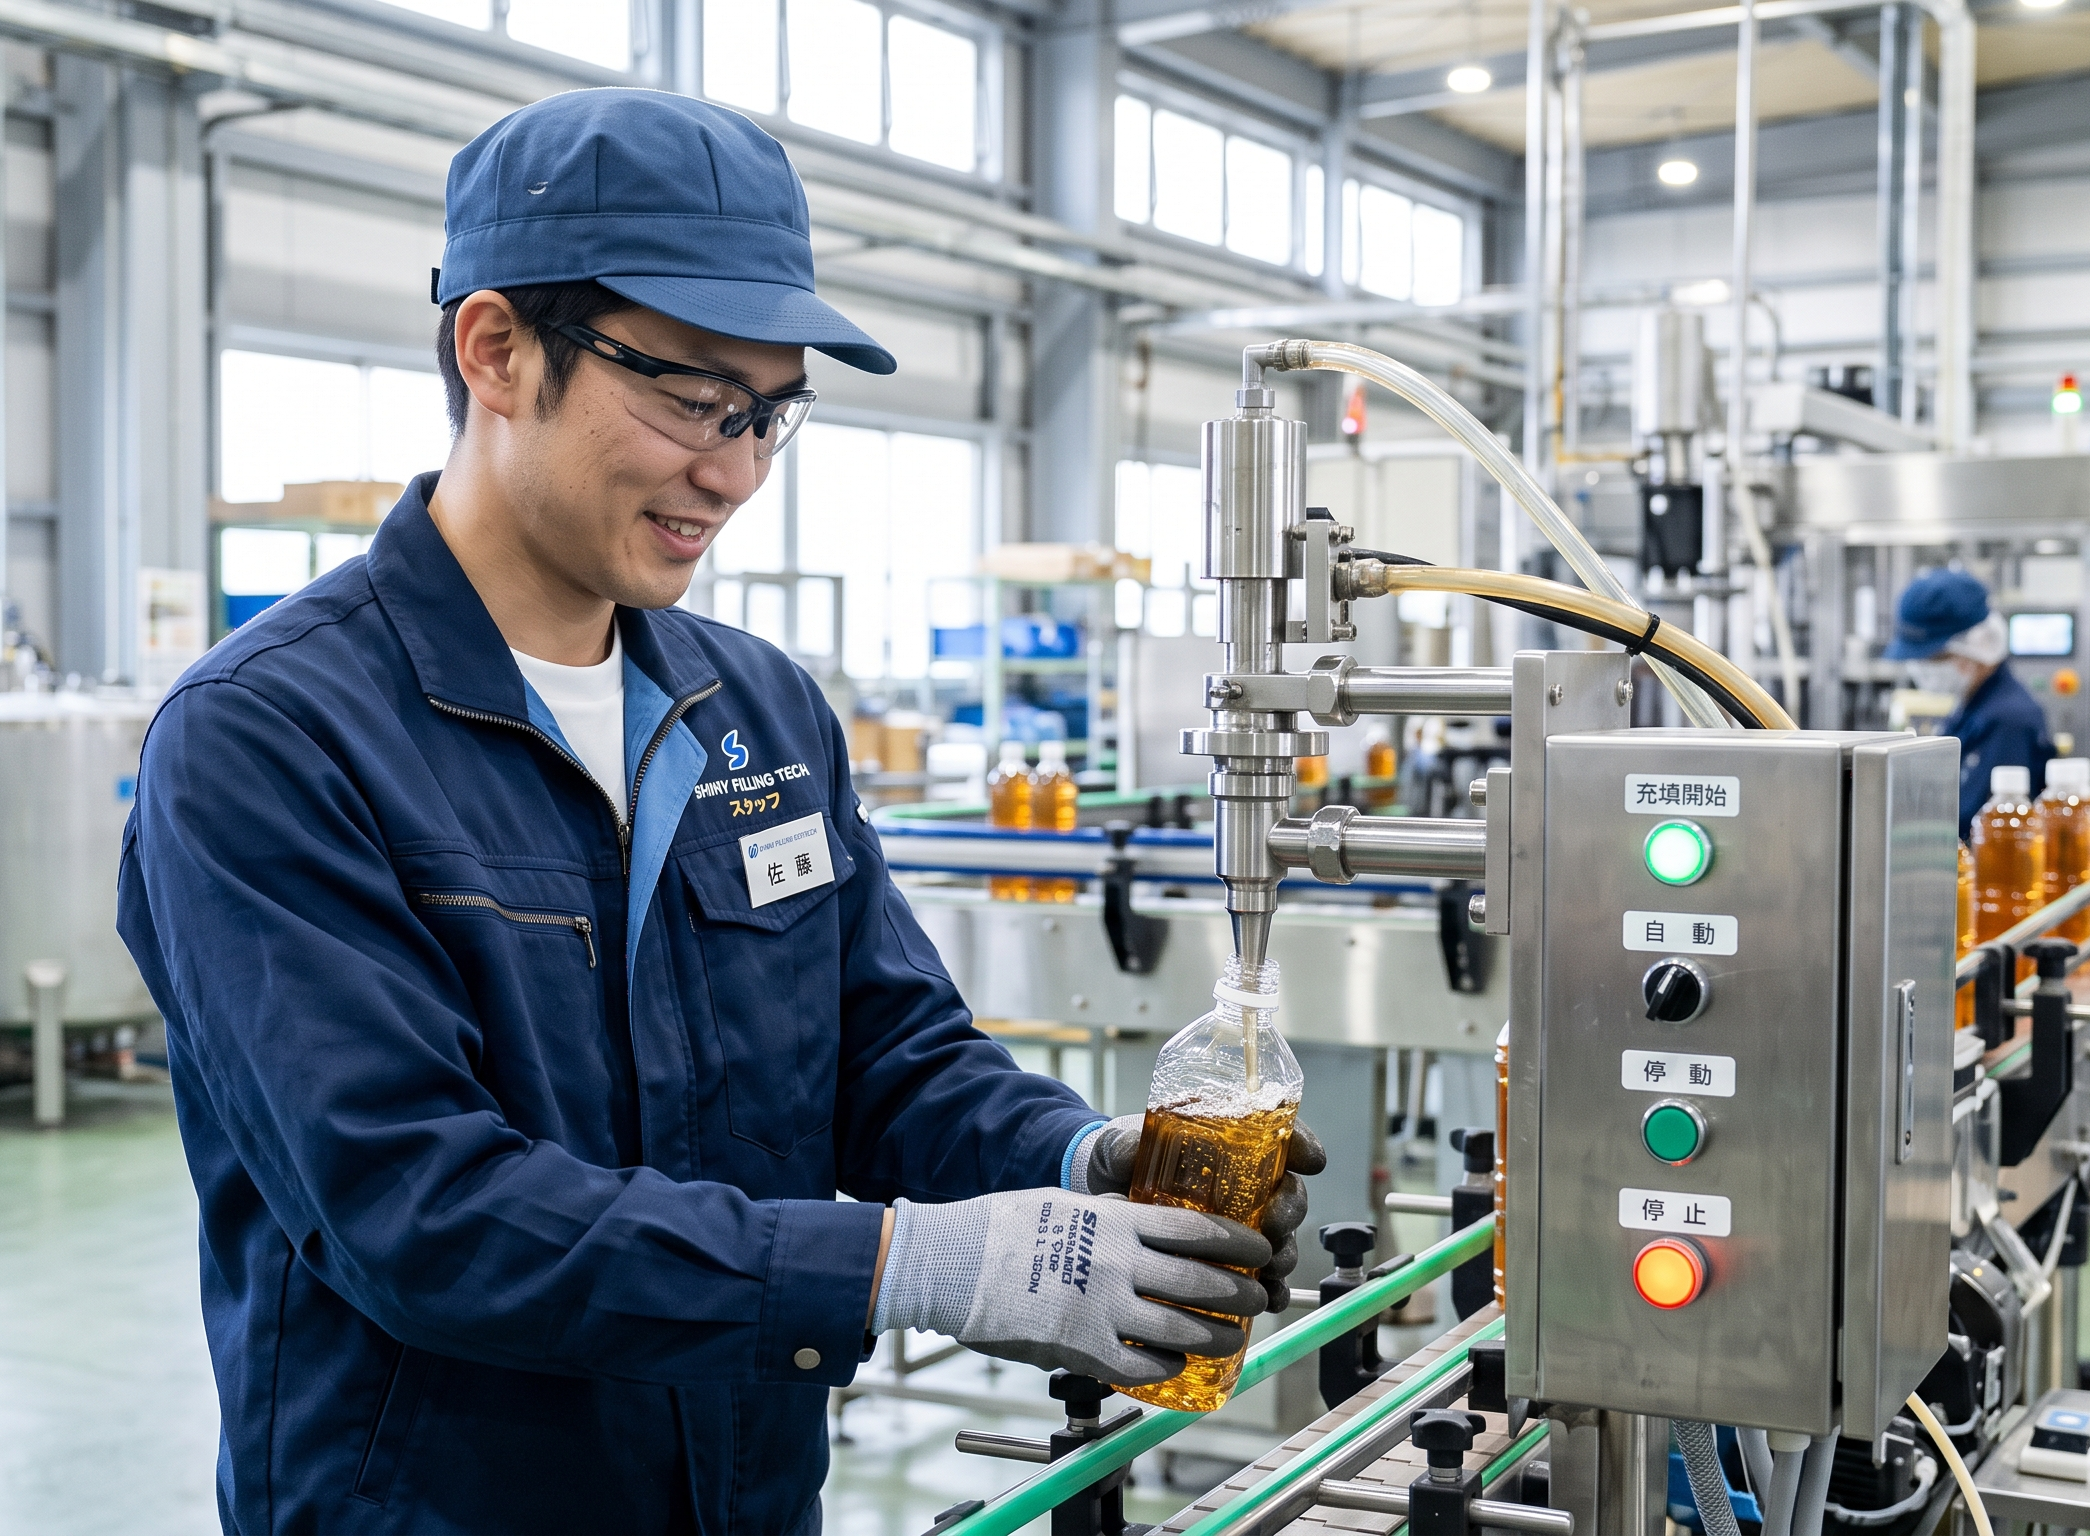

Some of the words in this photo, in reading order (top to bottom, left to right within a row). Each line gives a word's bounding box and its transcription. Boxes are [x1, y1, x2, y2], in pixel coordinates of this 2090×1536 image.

[694, 779, 729, 799] SHINY
[731, 772, 775, 792] FILLING
[774, 763, 811, 781] TECH
[1636, 782, 1727, 807] 充填開始
[729, 791, 780, 817] スタッフ
[767, 852, 813, 887] 佐藤
[1645, 919, 1715, 945] 自動
[1643, 1059, 1712, 1086] 停動
[1641, 1198, 1707, 1226] 停止
